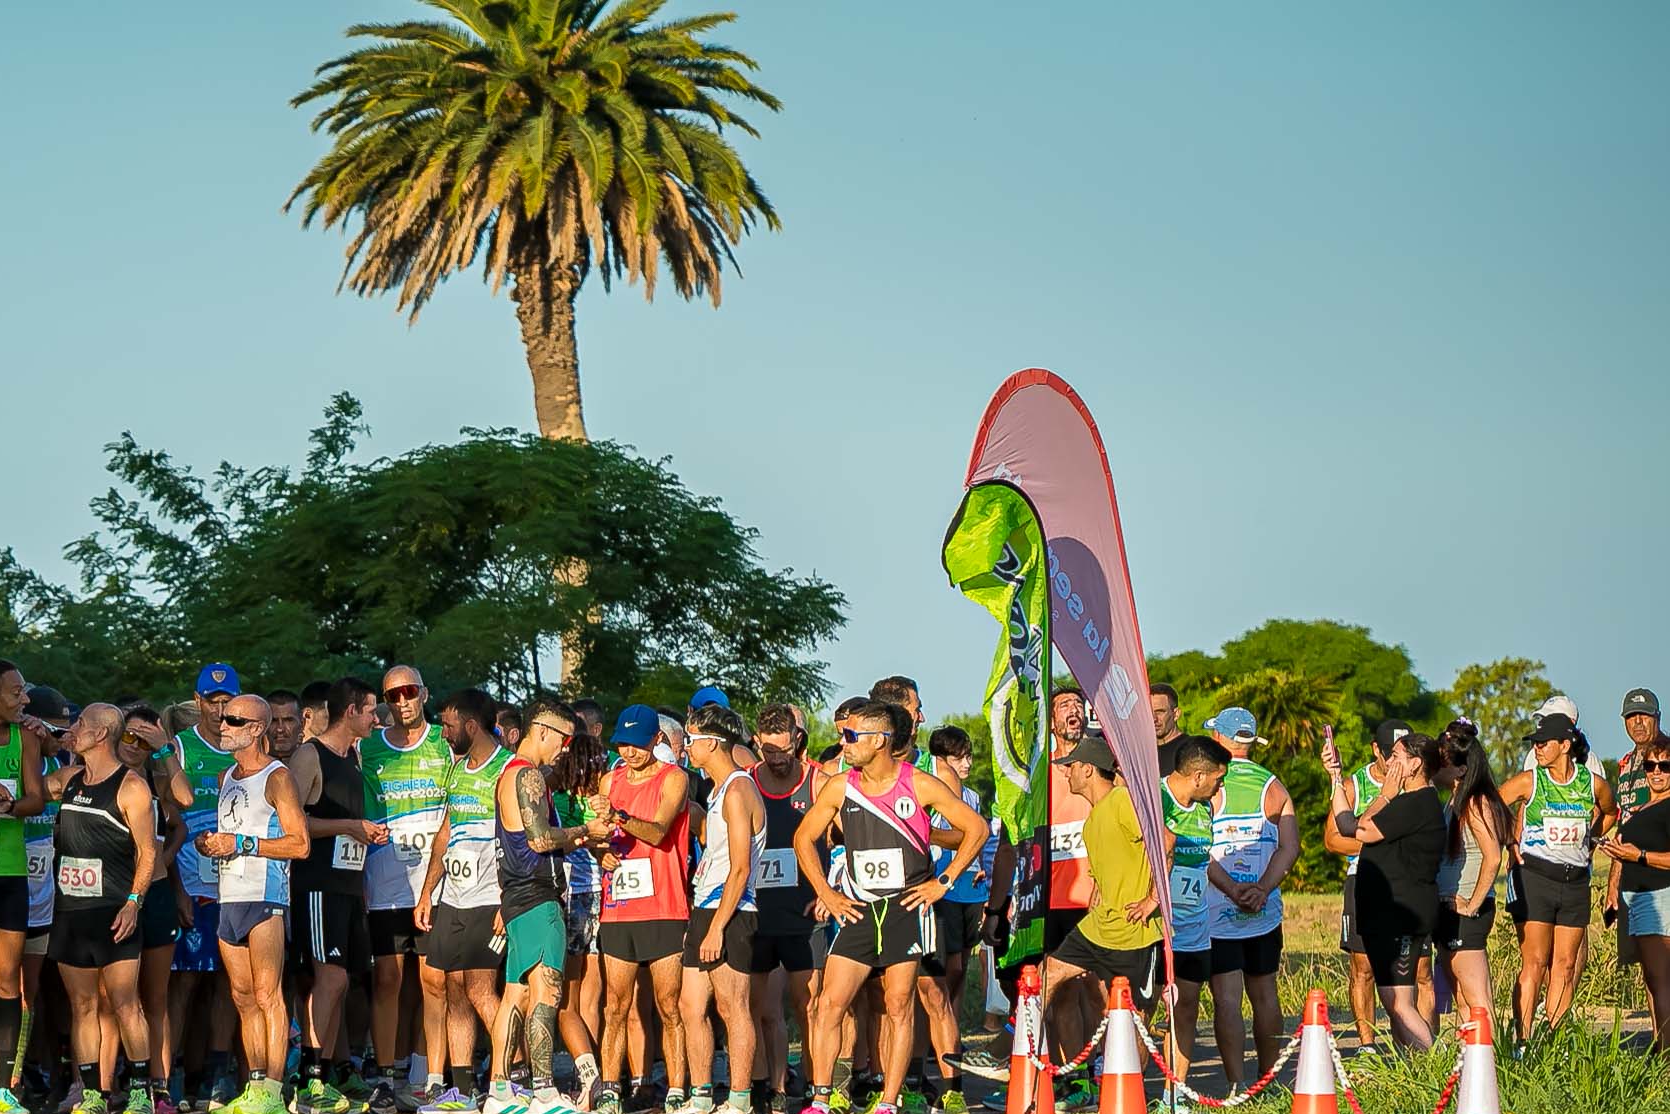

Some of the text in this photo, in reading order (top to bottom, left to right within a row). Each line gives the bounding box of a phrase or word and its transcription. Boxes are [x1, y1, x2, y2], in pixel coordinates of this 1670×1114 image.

[381, 779, 436, 792] FIGHIERA
[400, 832, 439, 852] 107
[1549, 826, 1579, 842] 521
[60, 867, 97, 888] 530
[445, 858, 472, 878] 106
[760, 860, 784, 879] 71
[864, 861, 890, 880] 98
[616, 871, 640, 890] 45
[1181, 877, 1202, 897] 74
